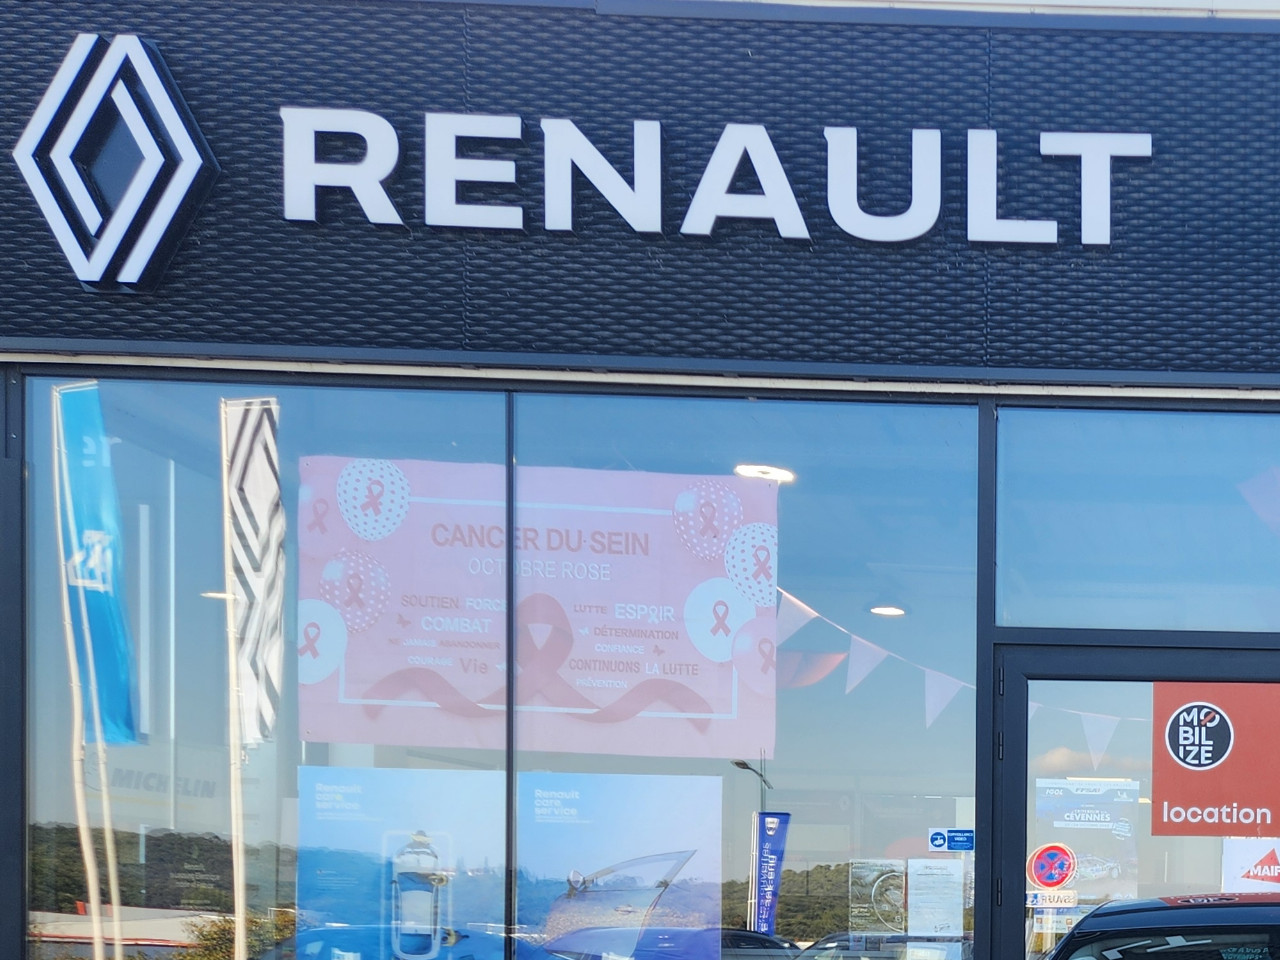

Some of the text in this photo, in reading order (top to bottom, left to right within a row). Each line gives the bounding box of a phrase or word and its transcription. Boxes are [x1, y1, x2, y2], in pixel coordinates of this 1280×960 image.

[280, 106, 1152, 245] RENAULT
[546, 528, 582, 552] DU
[590, 530, 649, 556] SEIN
[561, 561, 610, 581] ROSE
[401, 595, 459, 609] SOUTIEN
[574, 604, 608, 614] LUTTE
[421, 616, 492, 633] COMBAT
[594, 625, 678, 640] DÉTERMINATION
[594, 643, 646, 654] CONFIANCE
[460, 658, 489, 674] Vie
[569, 659, 699, 676] CONTINUONS LA LUTTE
[111, 767, 216, 799] MICHELIN
[535, 789, 580, 799] Renault
[535, 799, 561, 807] care
[535, 807, 578, 816] service
[1163, 801, 1271, 824] location
